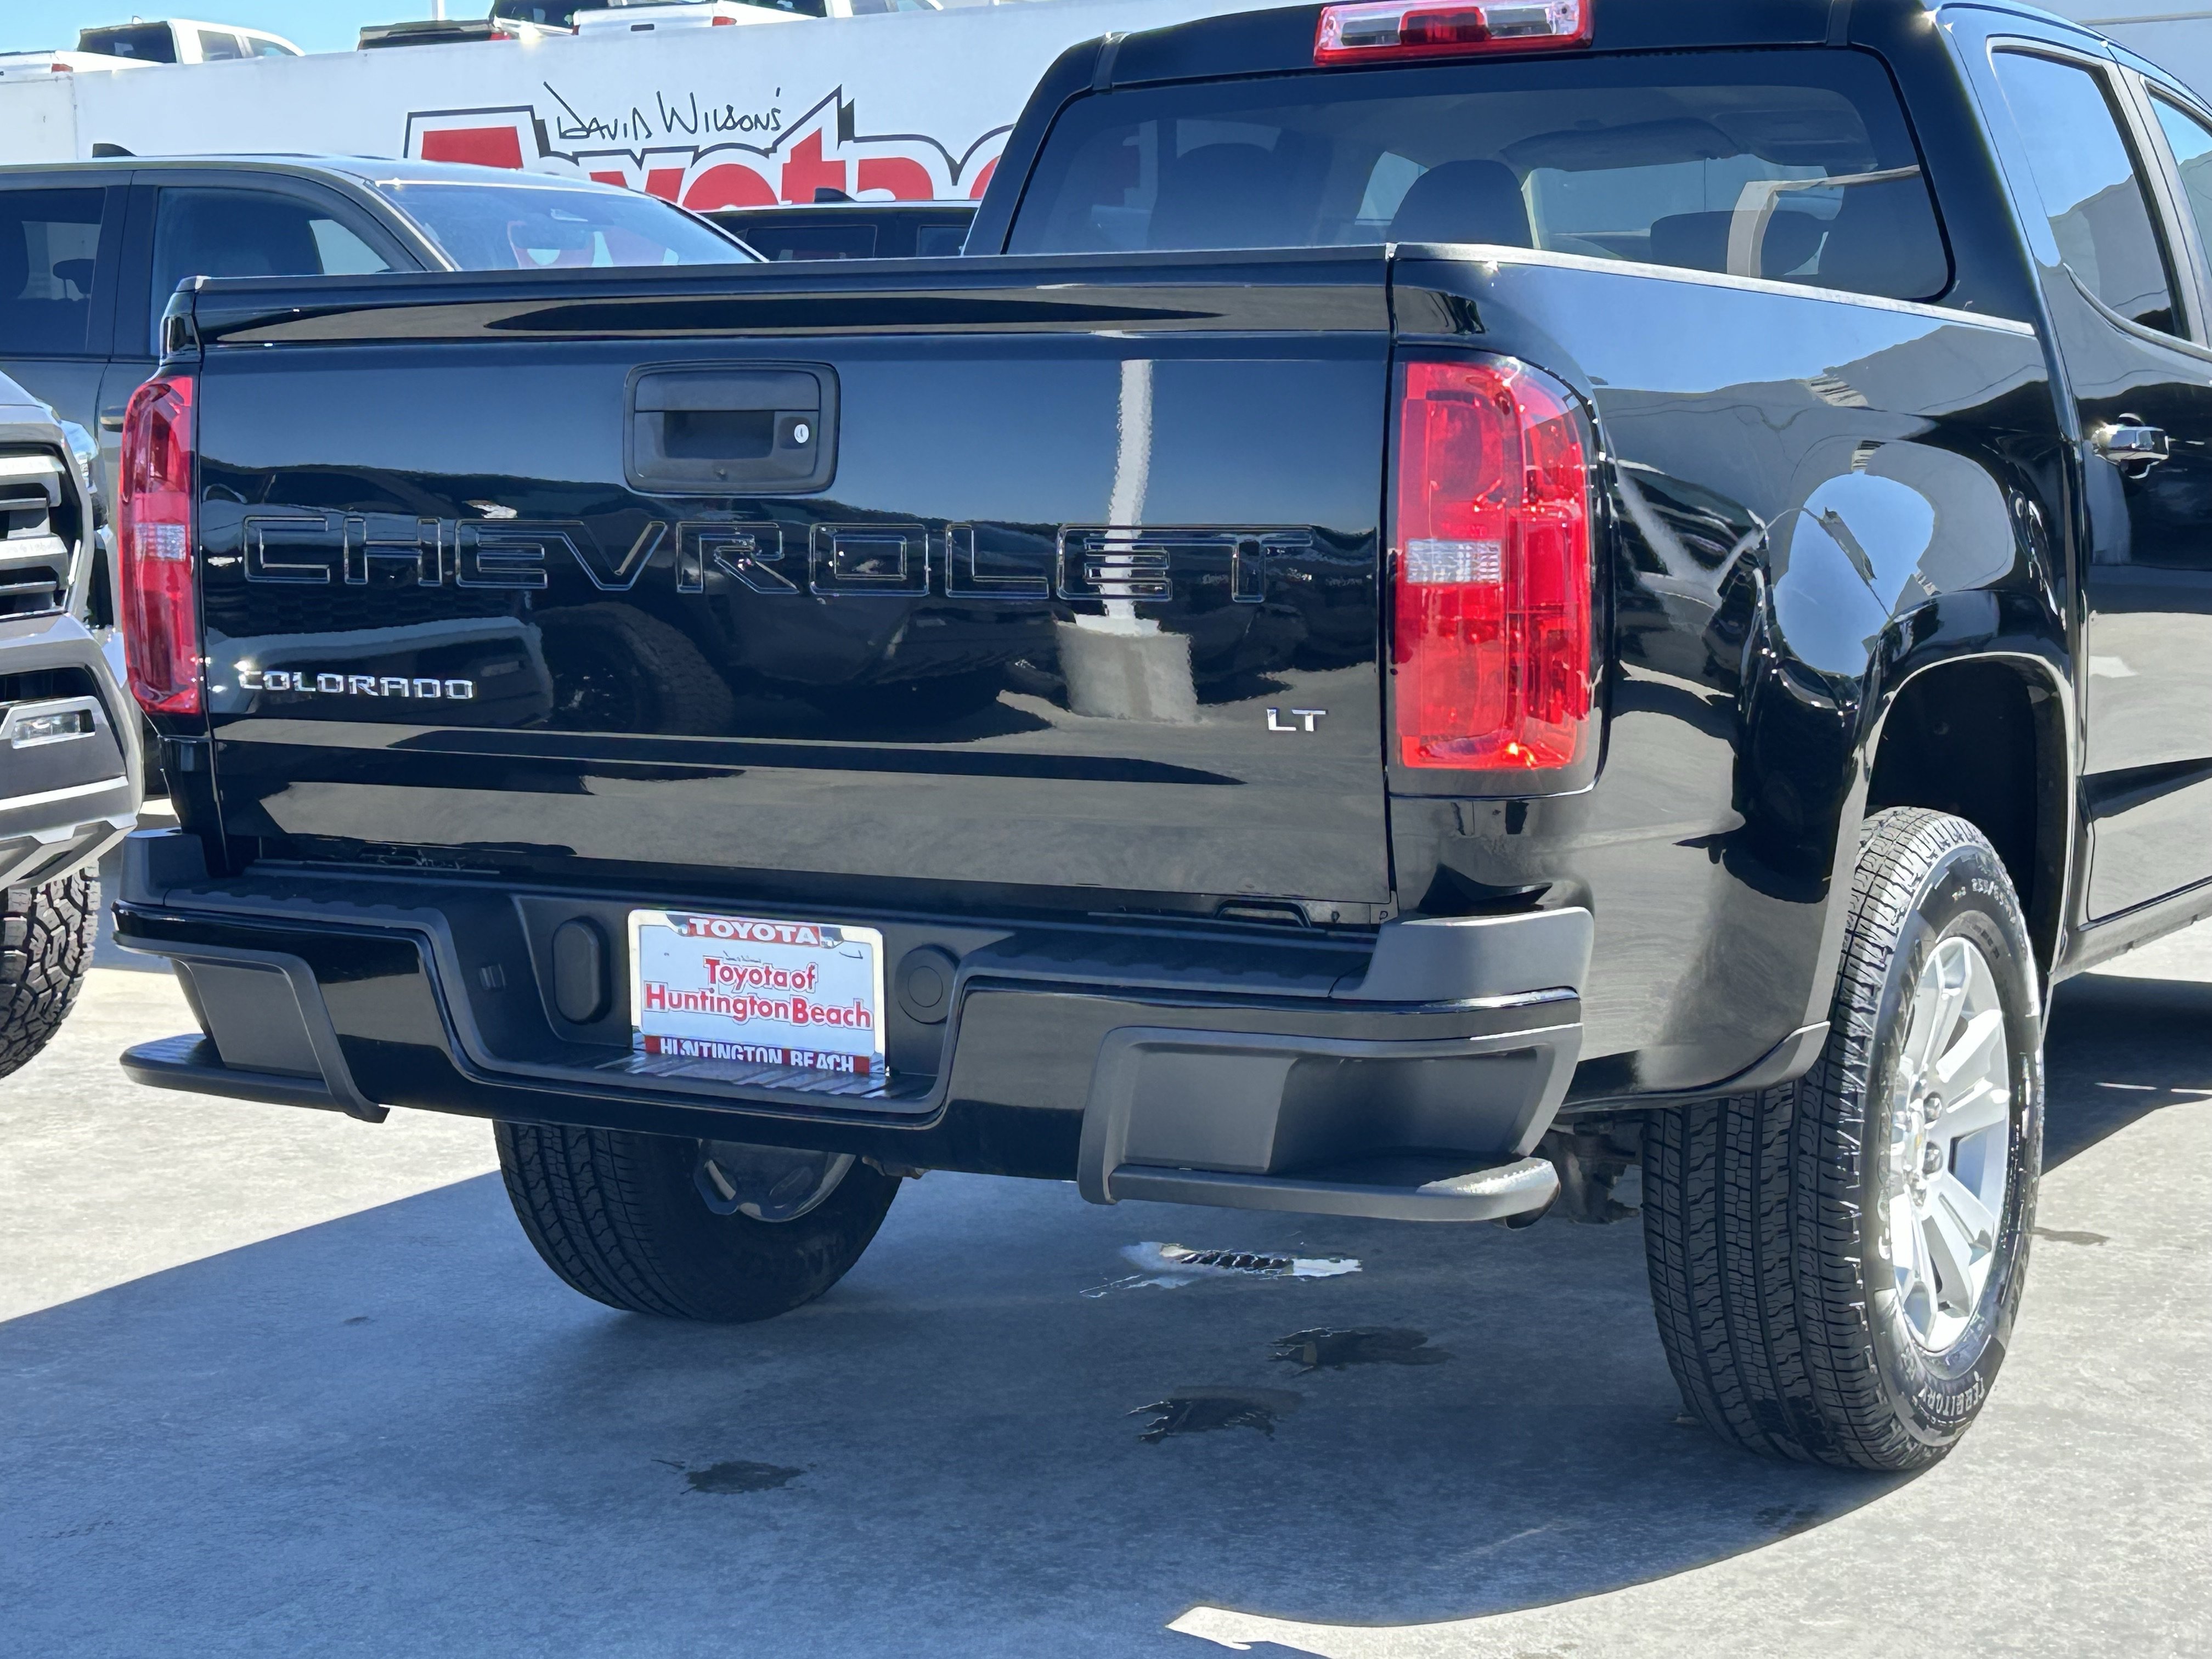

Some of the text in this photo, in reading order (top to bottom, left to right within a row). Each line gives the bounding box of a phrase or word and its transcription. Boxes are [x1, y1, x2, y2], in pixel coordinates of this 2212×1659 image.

[244, 515, 1314, 603] CHEVROLET
[238, 670, 474, 699] COLORADO
[1266, 708, 1327, 731] LT
[689, 917, 819, 945] TOYOTA
[704, 958, 816, 991] Toyota of
[645, 983, 871, 1028] Huntington Beach
[660, 1037, 854, 1073] HUNTINGTON BEACH
